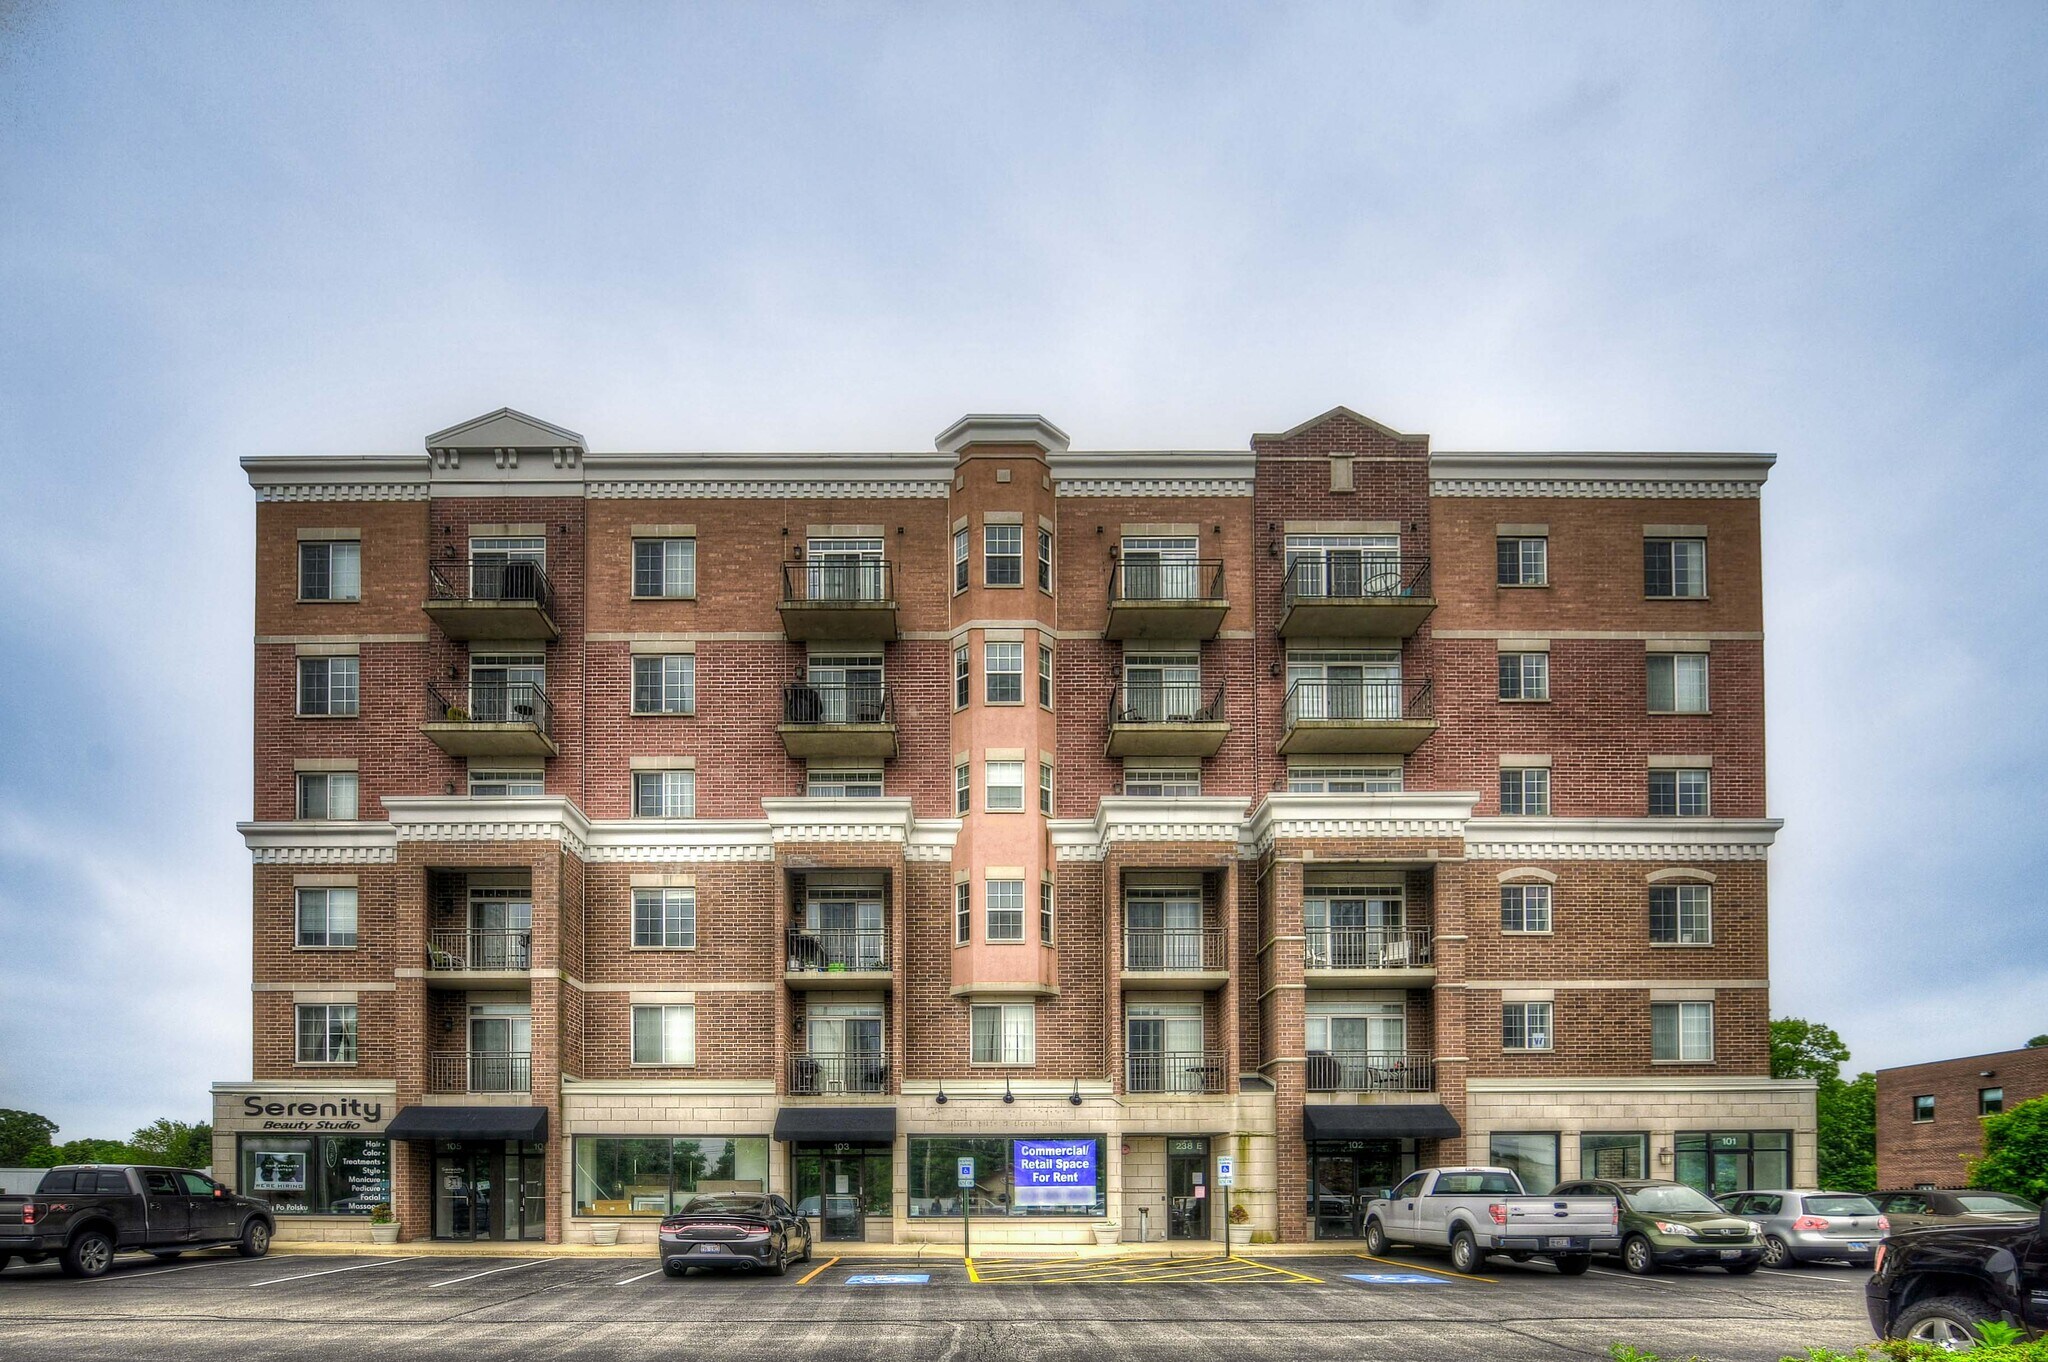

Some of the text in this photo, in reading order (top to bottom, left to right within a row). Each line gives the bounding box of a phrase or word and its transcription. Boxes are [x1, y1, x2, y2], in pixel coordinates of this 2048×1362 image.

[244, 1096, 382, 1123] Serenity
[263, 1120, 361, 1131] Beauty Studio
[365, 1140, 381, 1148] Hair
[1348, 1141, 1364, 1149] 102
[1722, 1137, 1737, 1145] 101
[834, 1143, 850, 1151] 103
[1176, 1142, 1203, 1150] 238 E
[362, 1149, 381, 1157] Color
[1021, 1145, 1090, 1156] Commercial/
[1021, 1158, 1090, 1172] Retail Space
[362, 1167, 381, 1176] Style
[1032, 1172, 1079, 1183] For Rent
[351, 1184, 381, 1192] Pedicure
[360, 1193, 381, 1201] Facial
[276, 1203, 285, 1211] Po
[286, 1203, 308, 1211] Polsku
